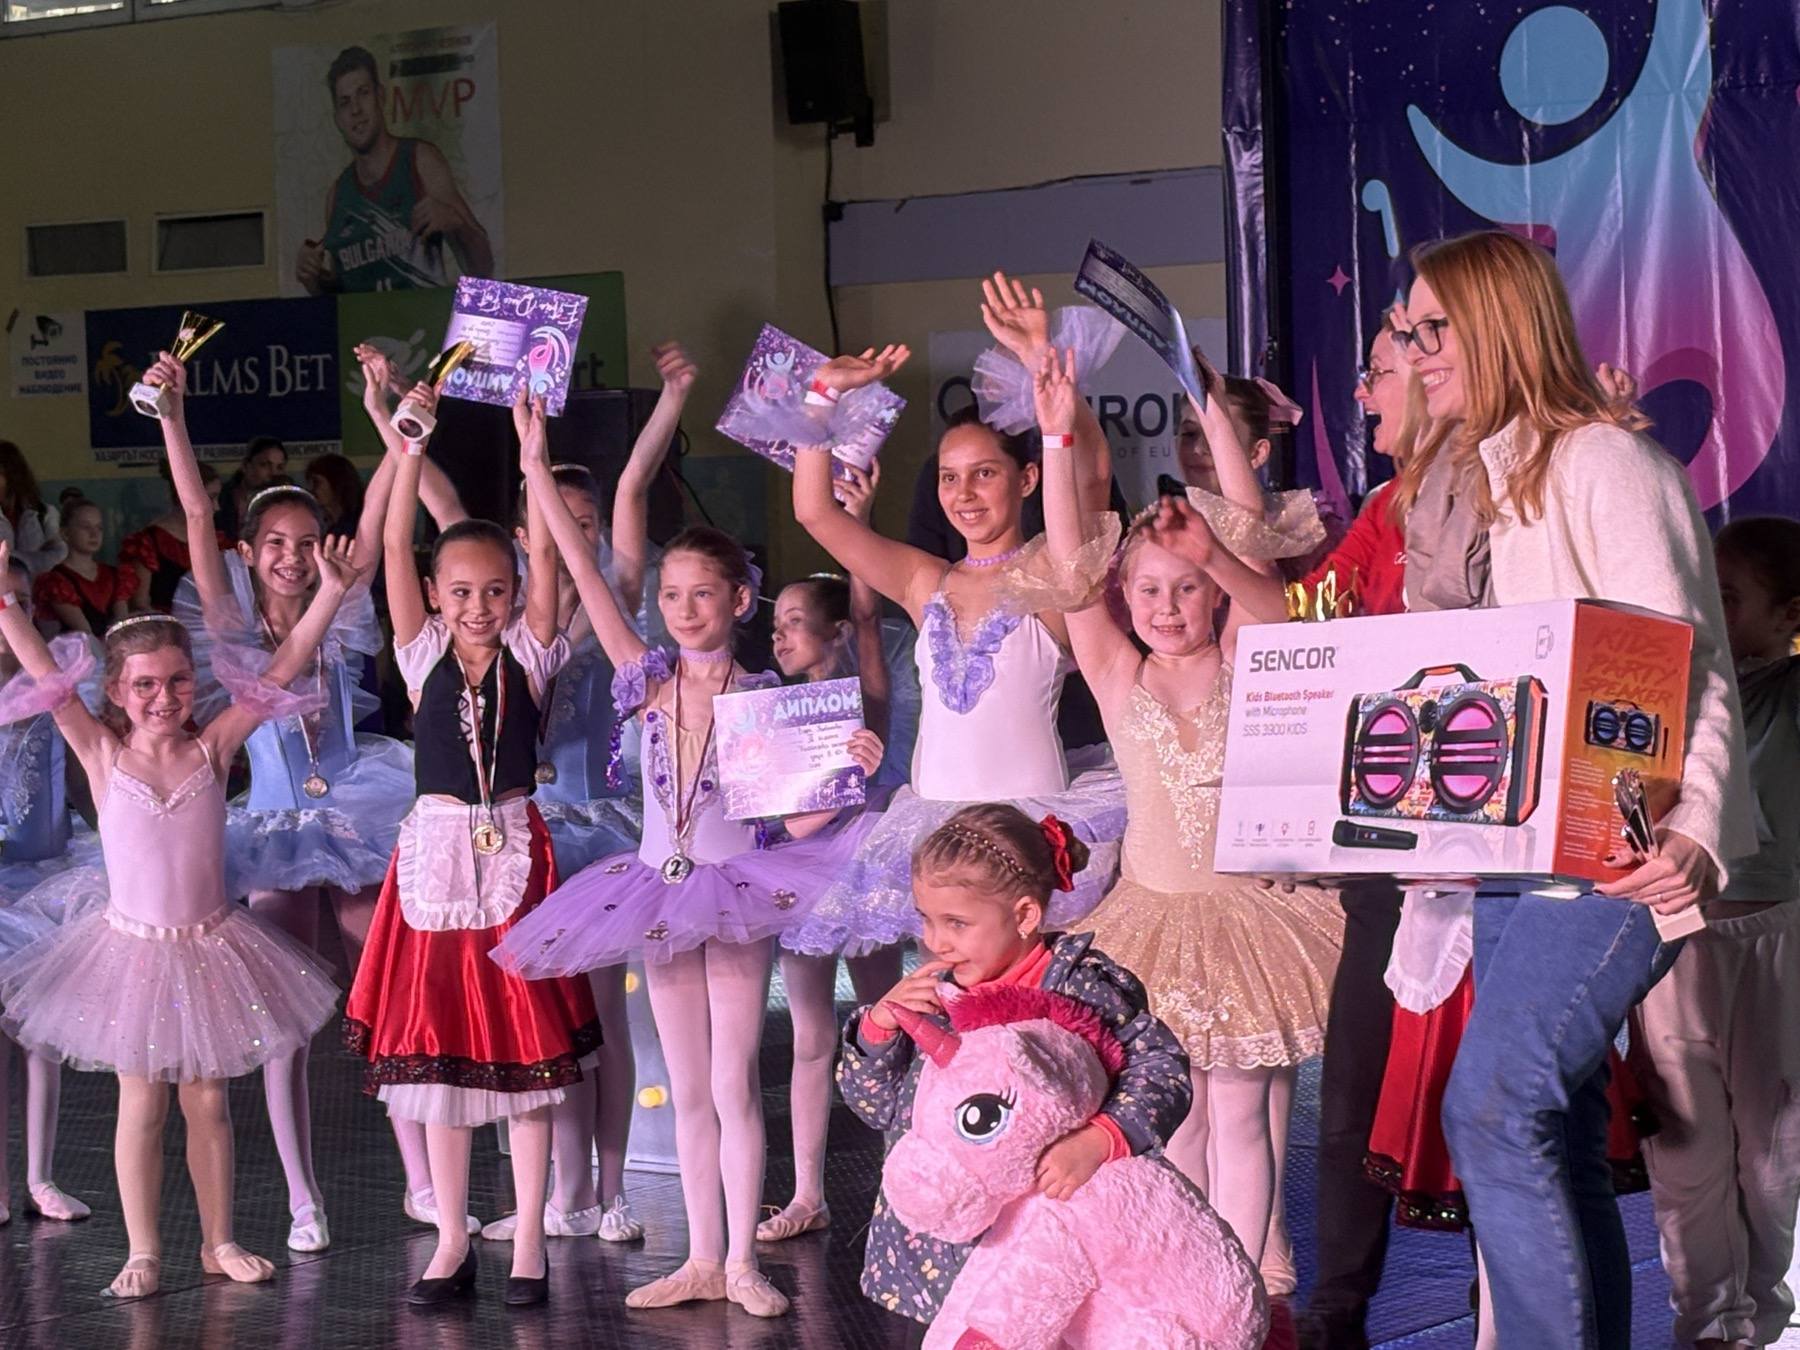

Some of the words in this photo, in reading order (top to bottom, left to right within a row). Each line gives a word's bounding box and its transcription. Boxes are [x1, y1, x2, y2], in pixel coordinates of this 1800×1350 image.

[391, 78, 476, 124] MVP
[1249, 646, 1336, 673] SENCOR
[774, 691, 859, 722] ДИПЛОМ
[1264, 690, 1301, 702] Bluetooth
[1303, 689, 1334, 702] Speaker
[1263, 706, 1307, 718] Microphone
[670, 859, 681, 877] 2
